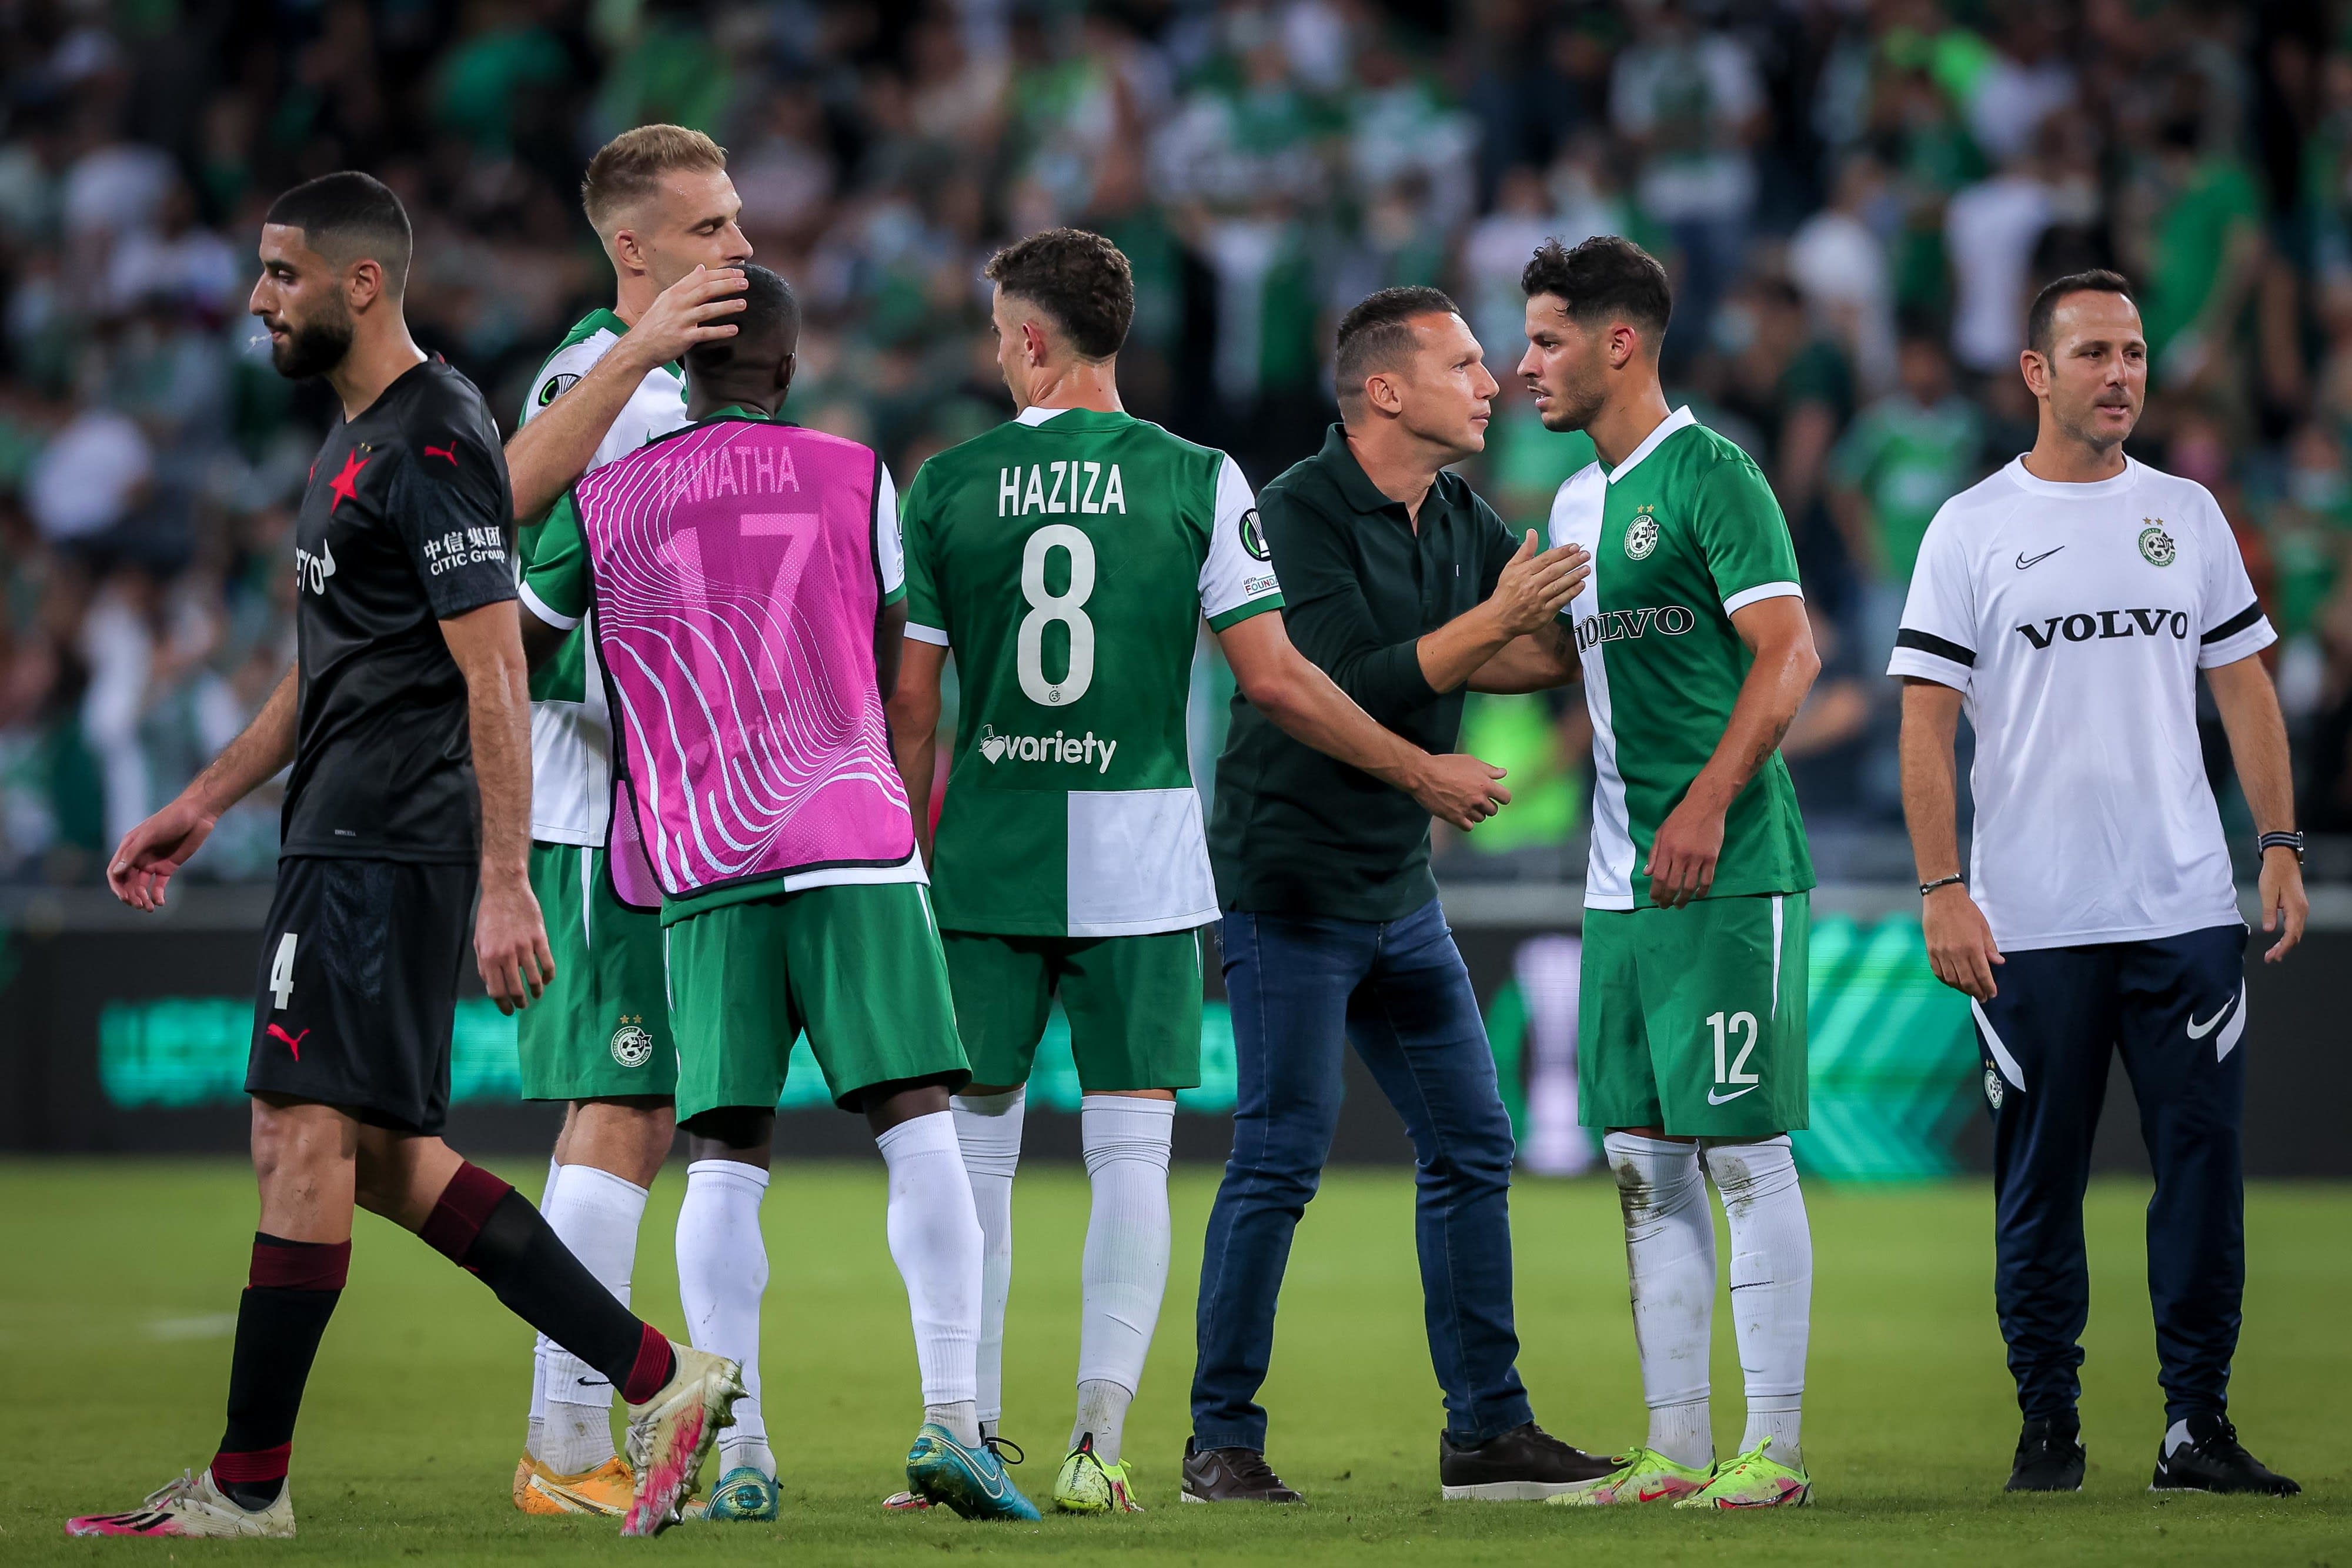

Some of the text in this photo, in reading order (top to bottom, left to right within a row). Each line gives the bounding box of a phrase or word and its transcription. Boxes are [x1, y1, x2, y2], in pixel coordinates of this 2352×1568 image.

[656, 446, 800, 508] TAWATHA
[998, 460, 1127, 517] HAZIZA
[423, 526, 501, 561] 中信集团
[430, 549, 506, 576] CITIC Group
[1244, 577, 1257, 586] UEFA
[656, 512, 819, 707] 17
[1017, 524, 1096, 707] 8
[2015, 609, 2188, 650] VOLVO
[1005, 730, 1117, 774] variety
[269, 932, 298, 1011] 4
[1706, 1011, 1759, 1084] 12
[1070, 1457, 1084, 1492] ERCURIAL
